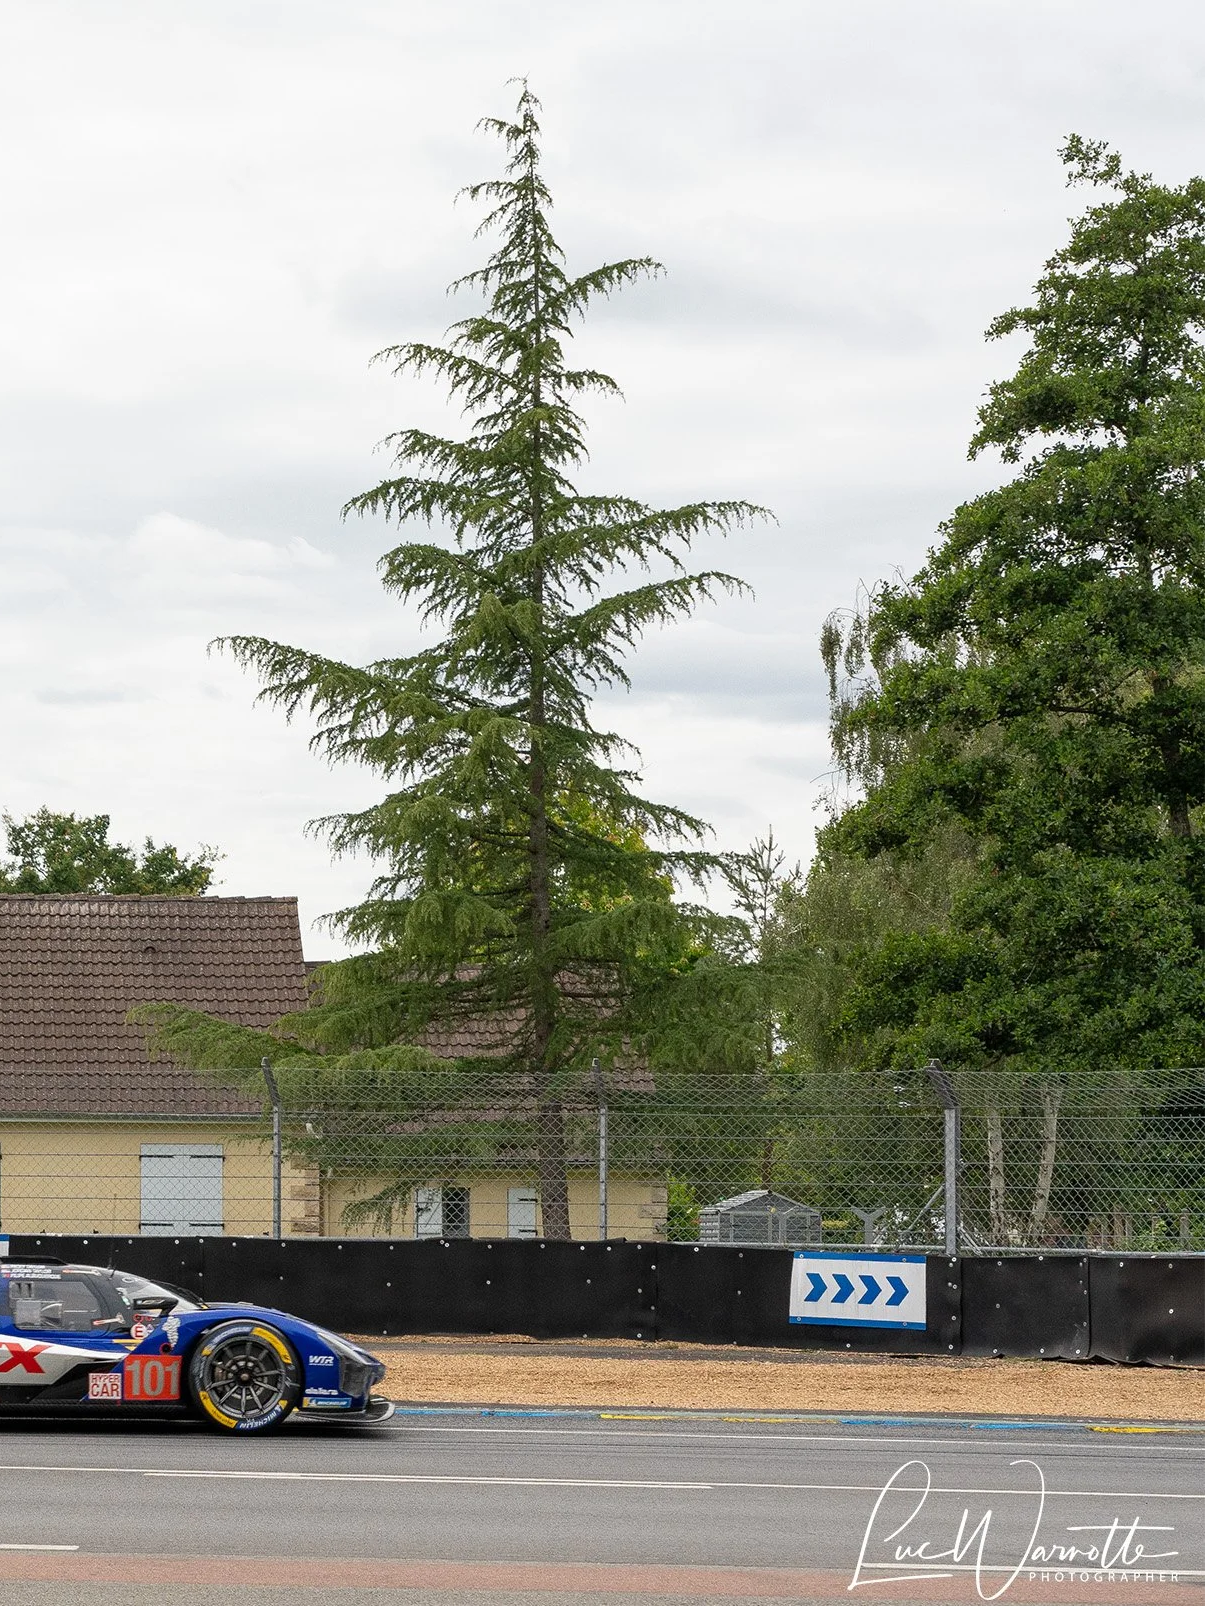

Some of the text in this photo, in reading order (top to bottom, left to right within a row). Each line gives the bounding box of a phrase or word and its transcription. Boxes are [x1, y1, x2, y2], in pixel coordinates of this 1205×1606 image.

[135, 1326, 143, 1337] E
[309, 1355, 334, 1364] WTR
[91, 1374, 119, 1383] HYPER
[127, 1360, 179, 1396] 101
[91, 1383, 119, 1397] CAR
[239, 1411, 277, 1428] MICHELIN
